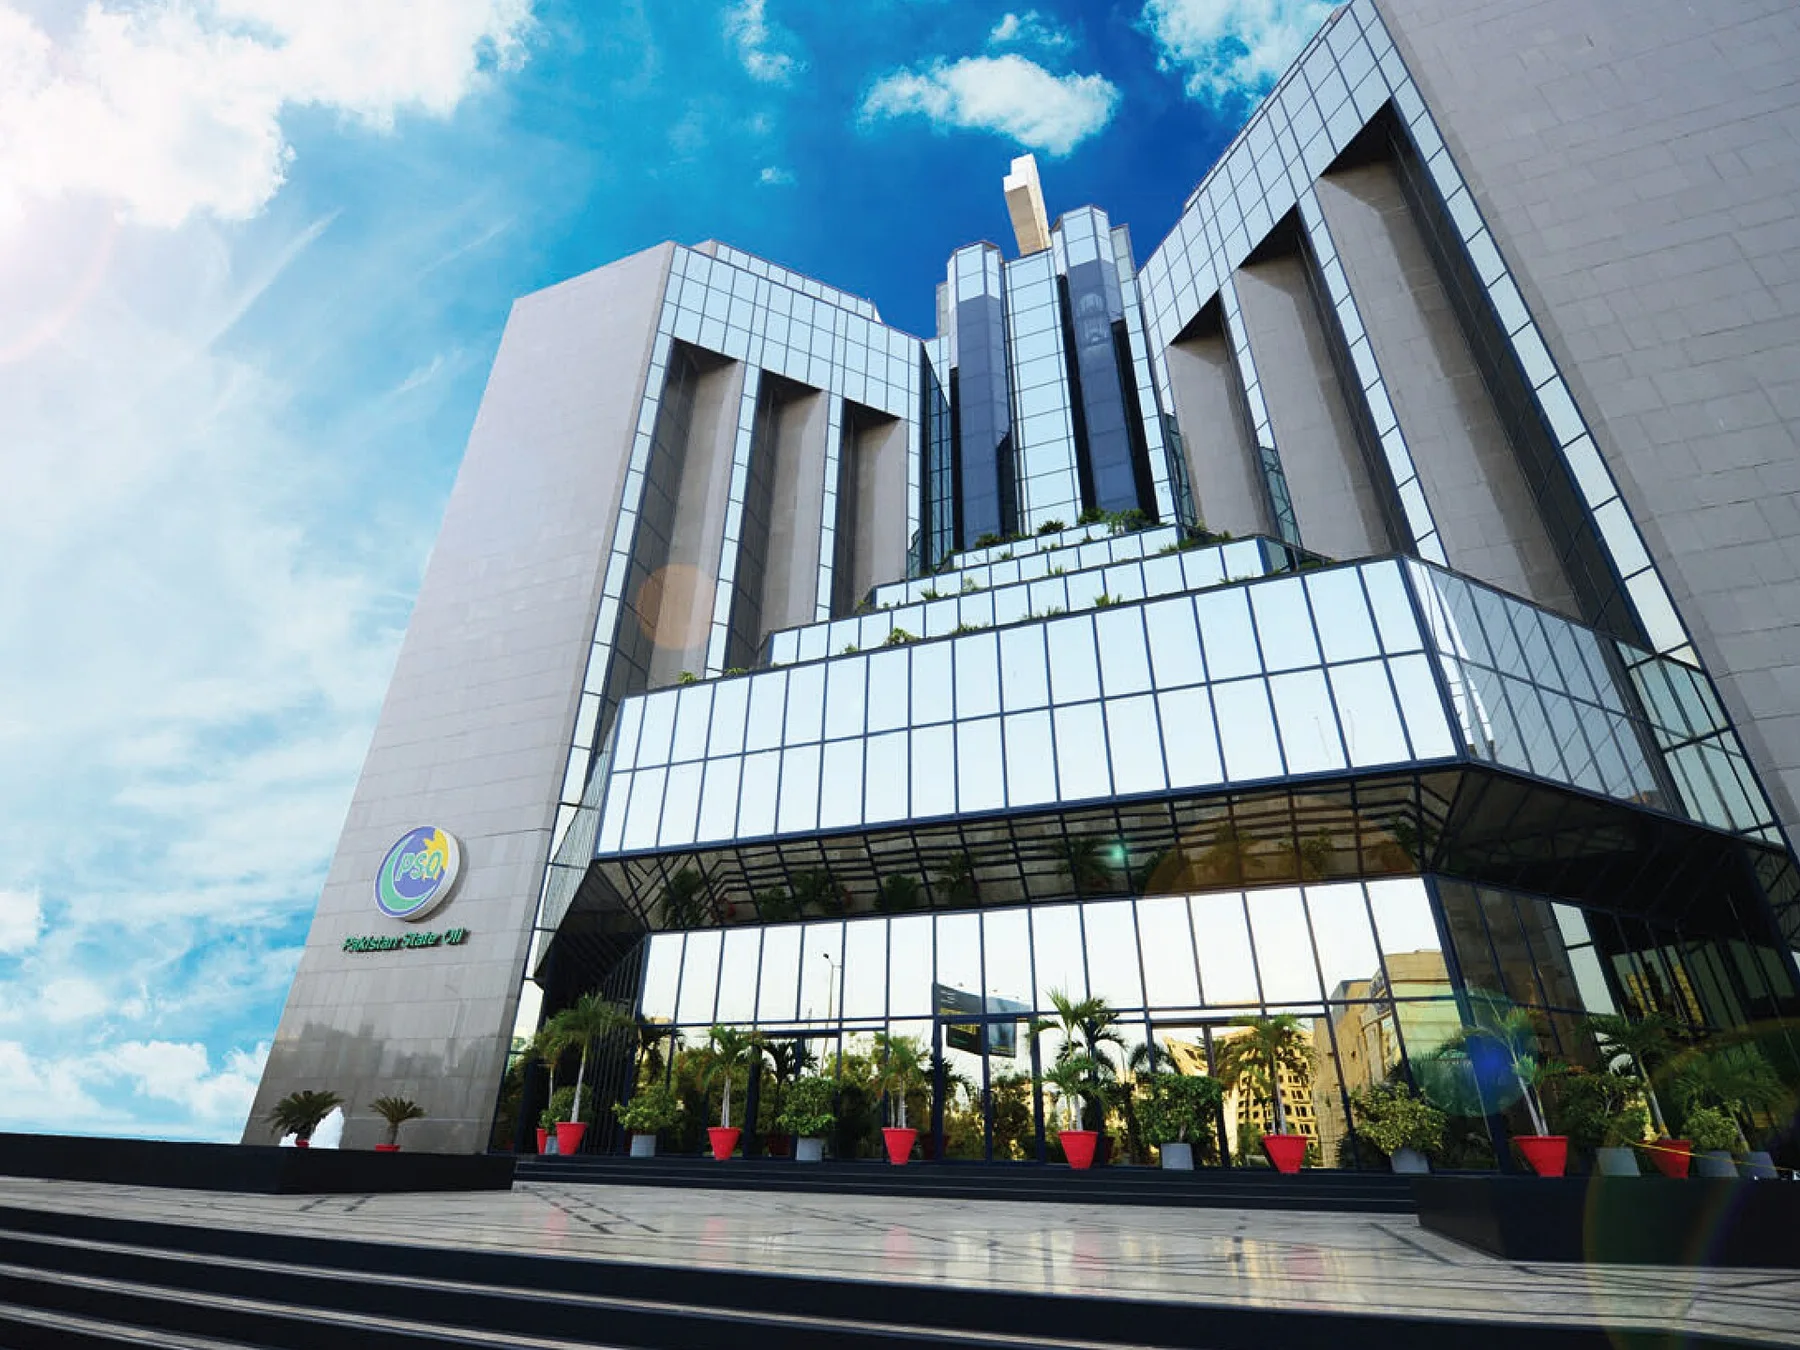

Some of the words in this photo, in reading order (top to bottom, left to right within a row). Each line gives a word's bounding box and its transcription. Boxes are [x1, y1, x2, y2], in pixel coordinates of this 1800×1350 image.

[395, 851, 444, 881] PSO
[342, 935, 399, 951] Pakistan
[402, 931, 439, 948] State
[443, 928, 465, 945] Oil
